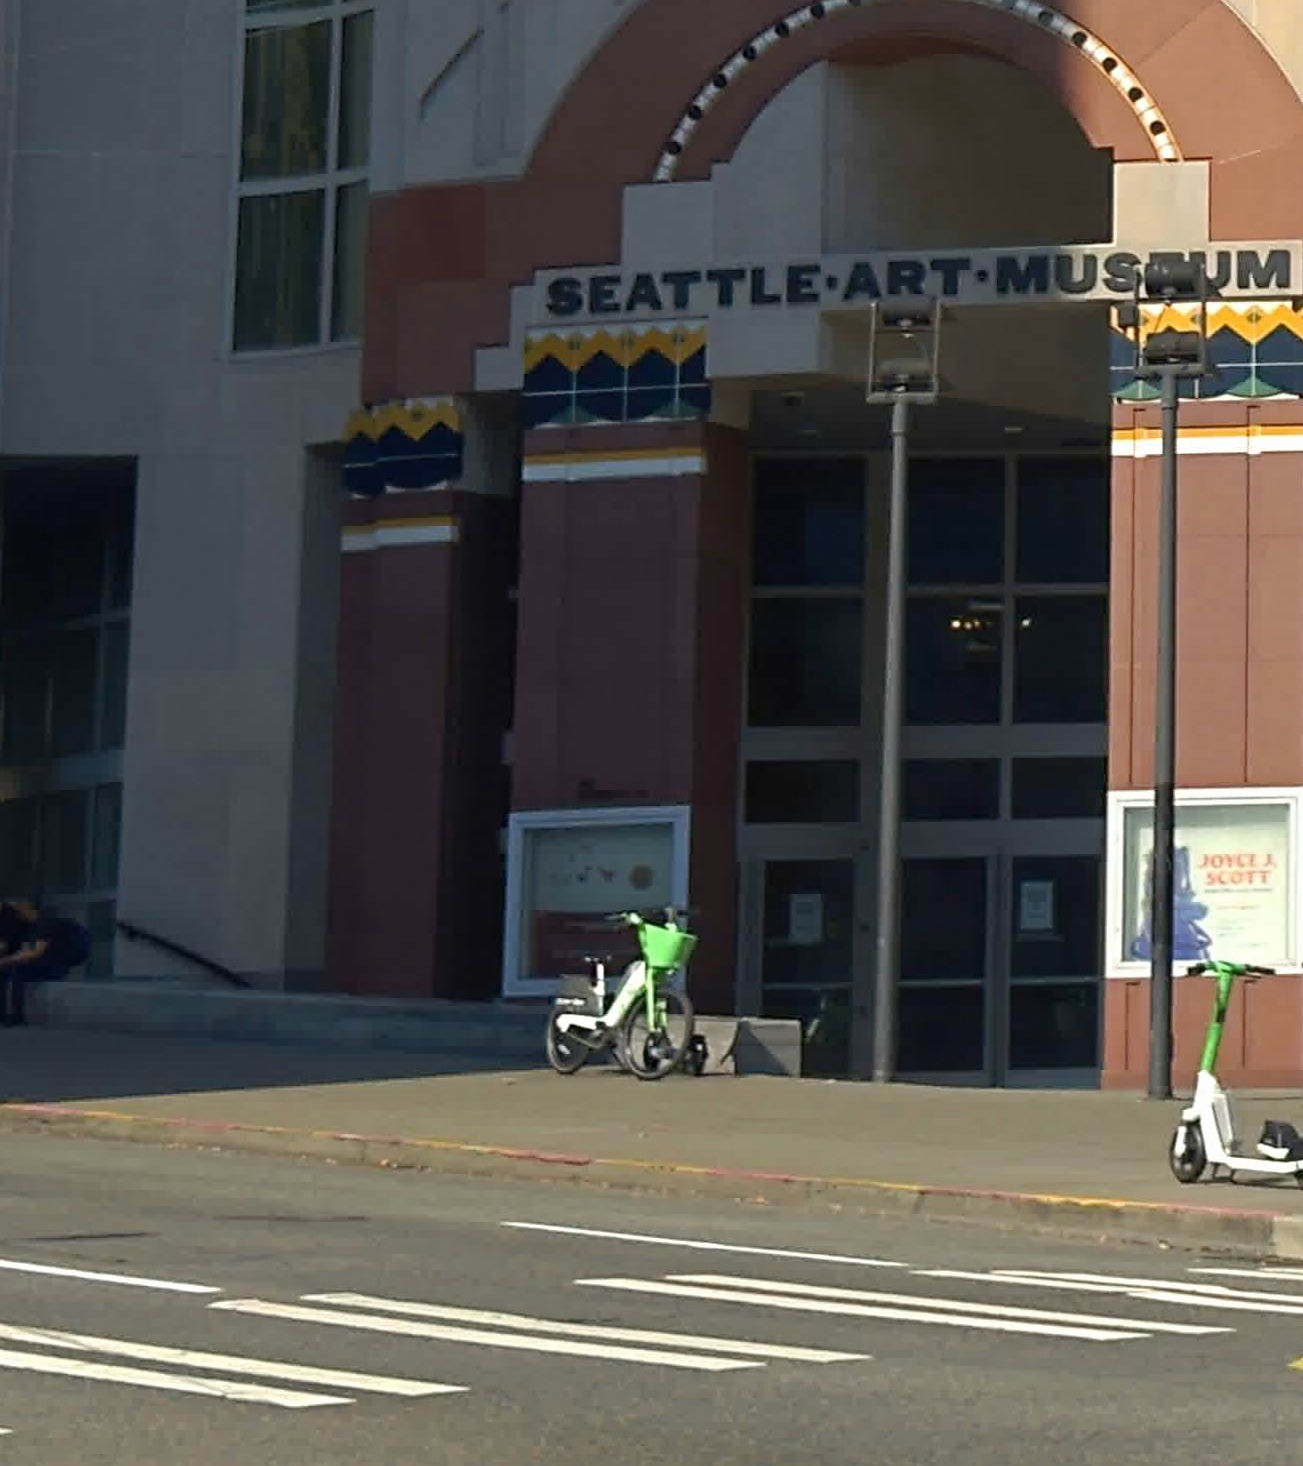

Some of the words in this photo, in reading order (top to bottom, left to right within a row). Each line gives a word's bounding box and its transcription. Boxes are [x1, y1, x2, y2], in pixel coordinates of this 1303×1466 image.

[546, 262, 821, 316] SEATTLE
[842, 256, 971, 301] ART
[1199, 853, 1256, 869] JOYCE
[1205, 870, 1272, 886] SCOTT
